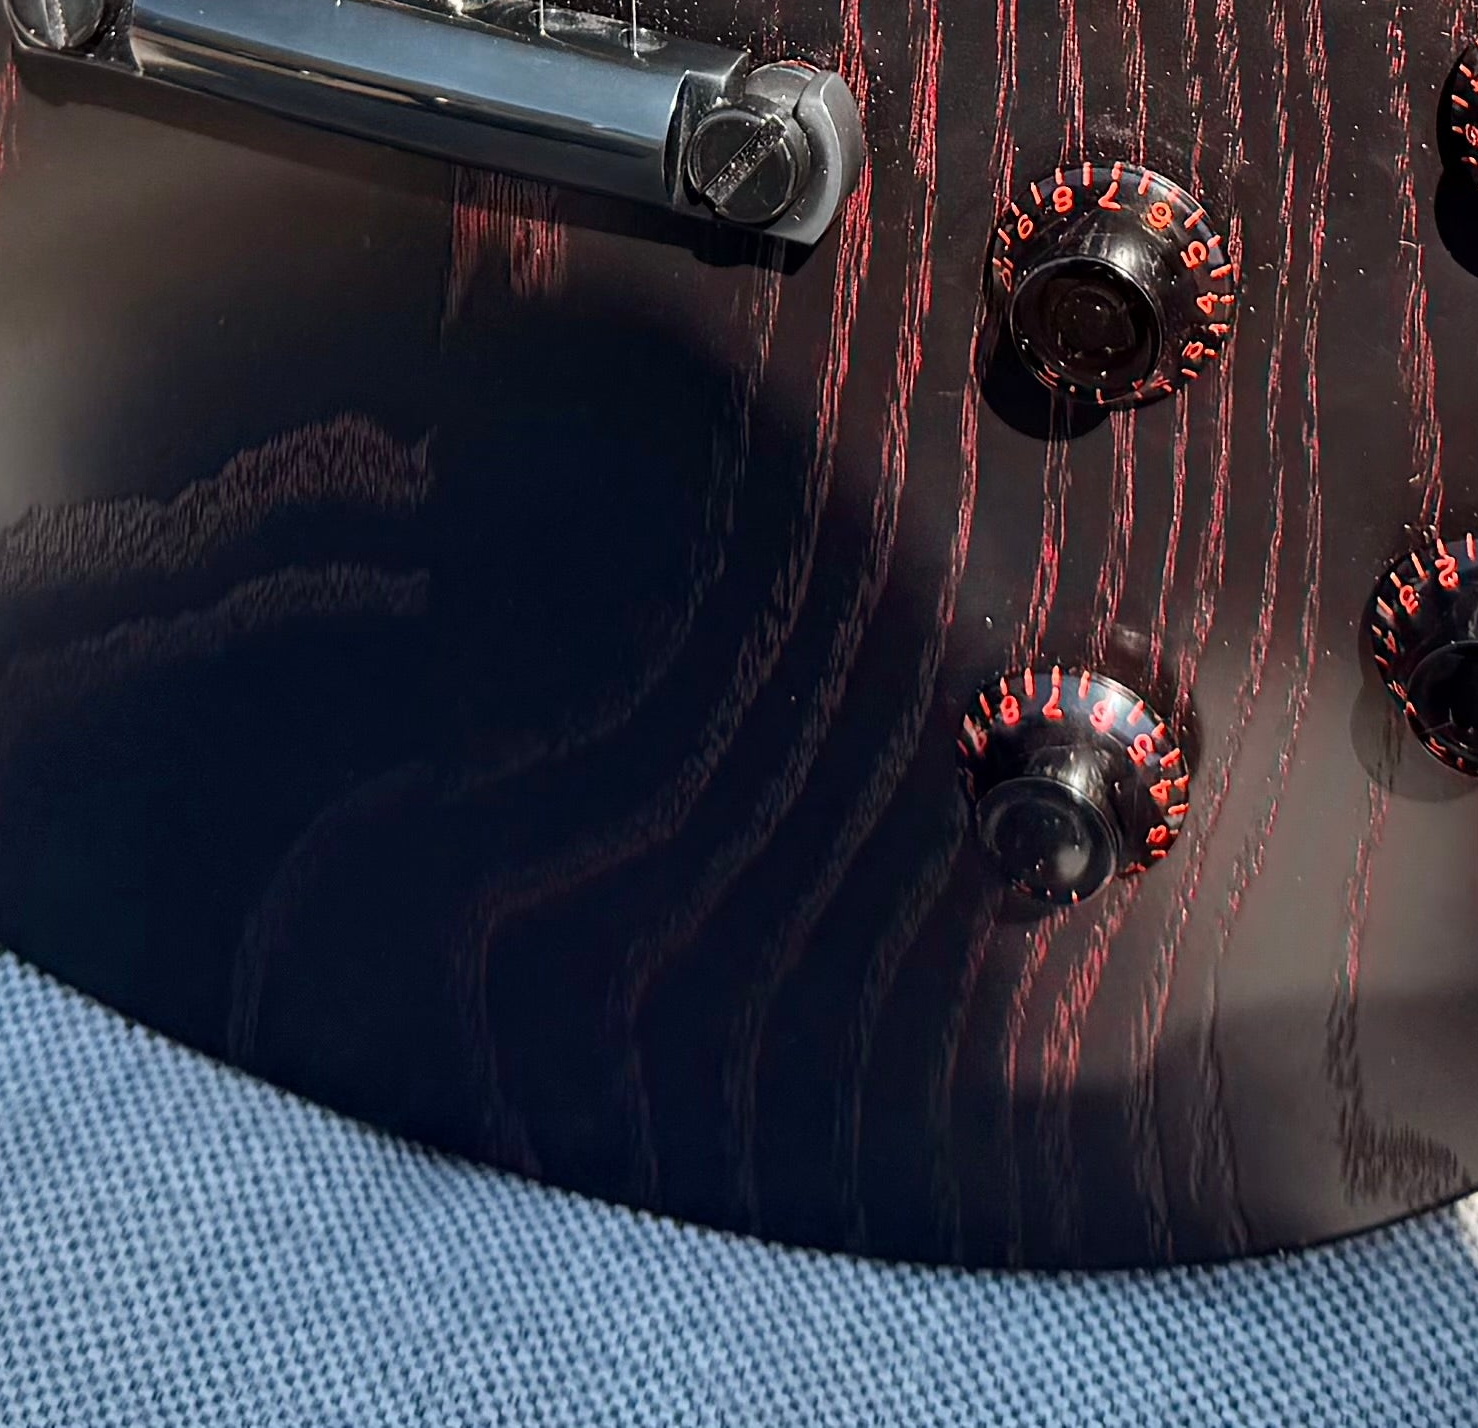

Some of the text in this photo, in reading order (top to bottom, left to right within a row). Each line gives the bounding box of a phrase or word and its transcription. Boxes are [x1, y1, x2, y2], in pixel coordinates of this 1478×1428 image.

[1052, 185, 1074, 214] 8
[1098, 181, 1121, 212] 7
[1146, 201, 1173, 231] 6
[1180, 240, 1207, 269] 5
[1196, 291, 1218, 315] 4
[1435, 554, 1459, 590] 2
[999, 694, 1021, 726] 8
[1042, 686, 1064, 720] 7
[1089, 700, 1115, 733] 6
[1127, 733, 1154, 766] 5
[1149, 779, 1171, 805] 4
